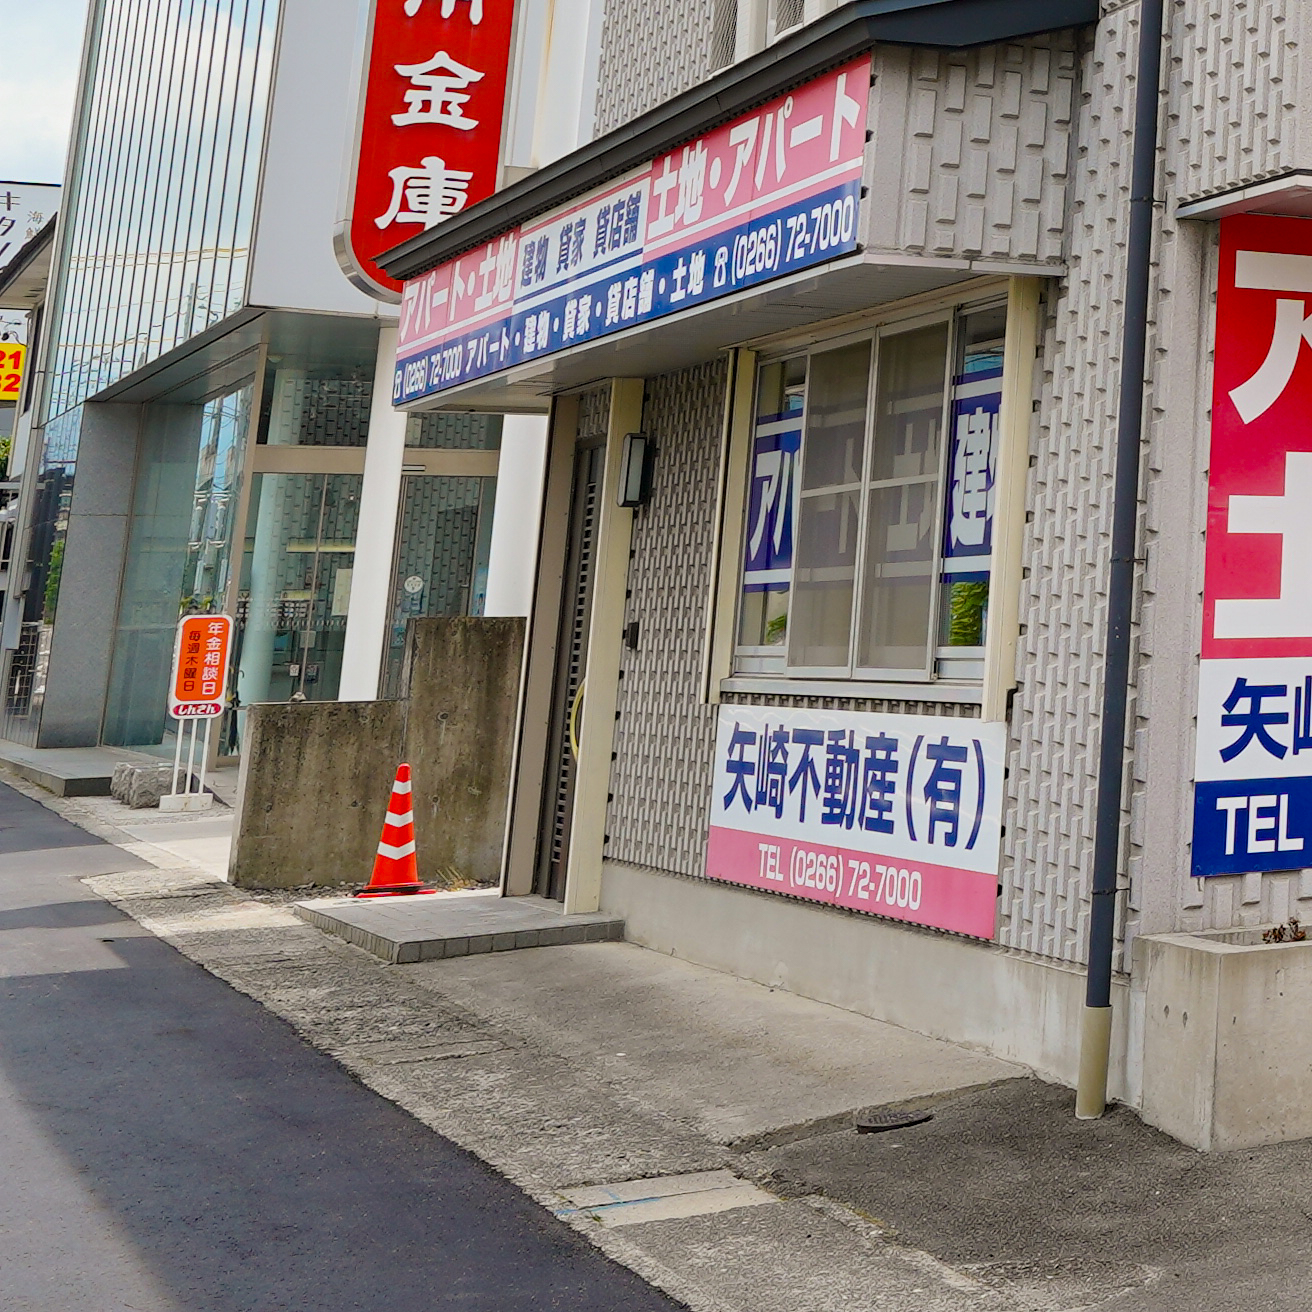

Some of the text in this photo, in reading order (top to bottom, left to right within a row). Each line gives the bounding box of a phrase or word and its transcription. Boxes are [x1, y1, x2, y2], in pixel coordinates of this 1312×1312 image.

[401, 72, 861, 343] アパート・土地 建物 貸家 貸店舗 土地・アパート
[731, 218, 782, 286] (0266)
[786, 194, 854, 263] 72-7000
[184, 631, 200, 691] 毎週木曜日
[202, 622, 224, 695] 年金相談日
[723, 721, 986, 850] 矢崎不動産(有)
[1215, 793, 1305, 857] TEL
[758, 842, 923, 912] TEL (0266) 72-7000
